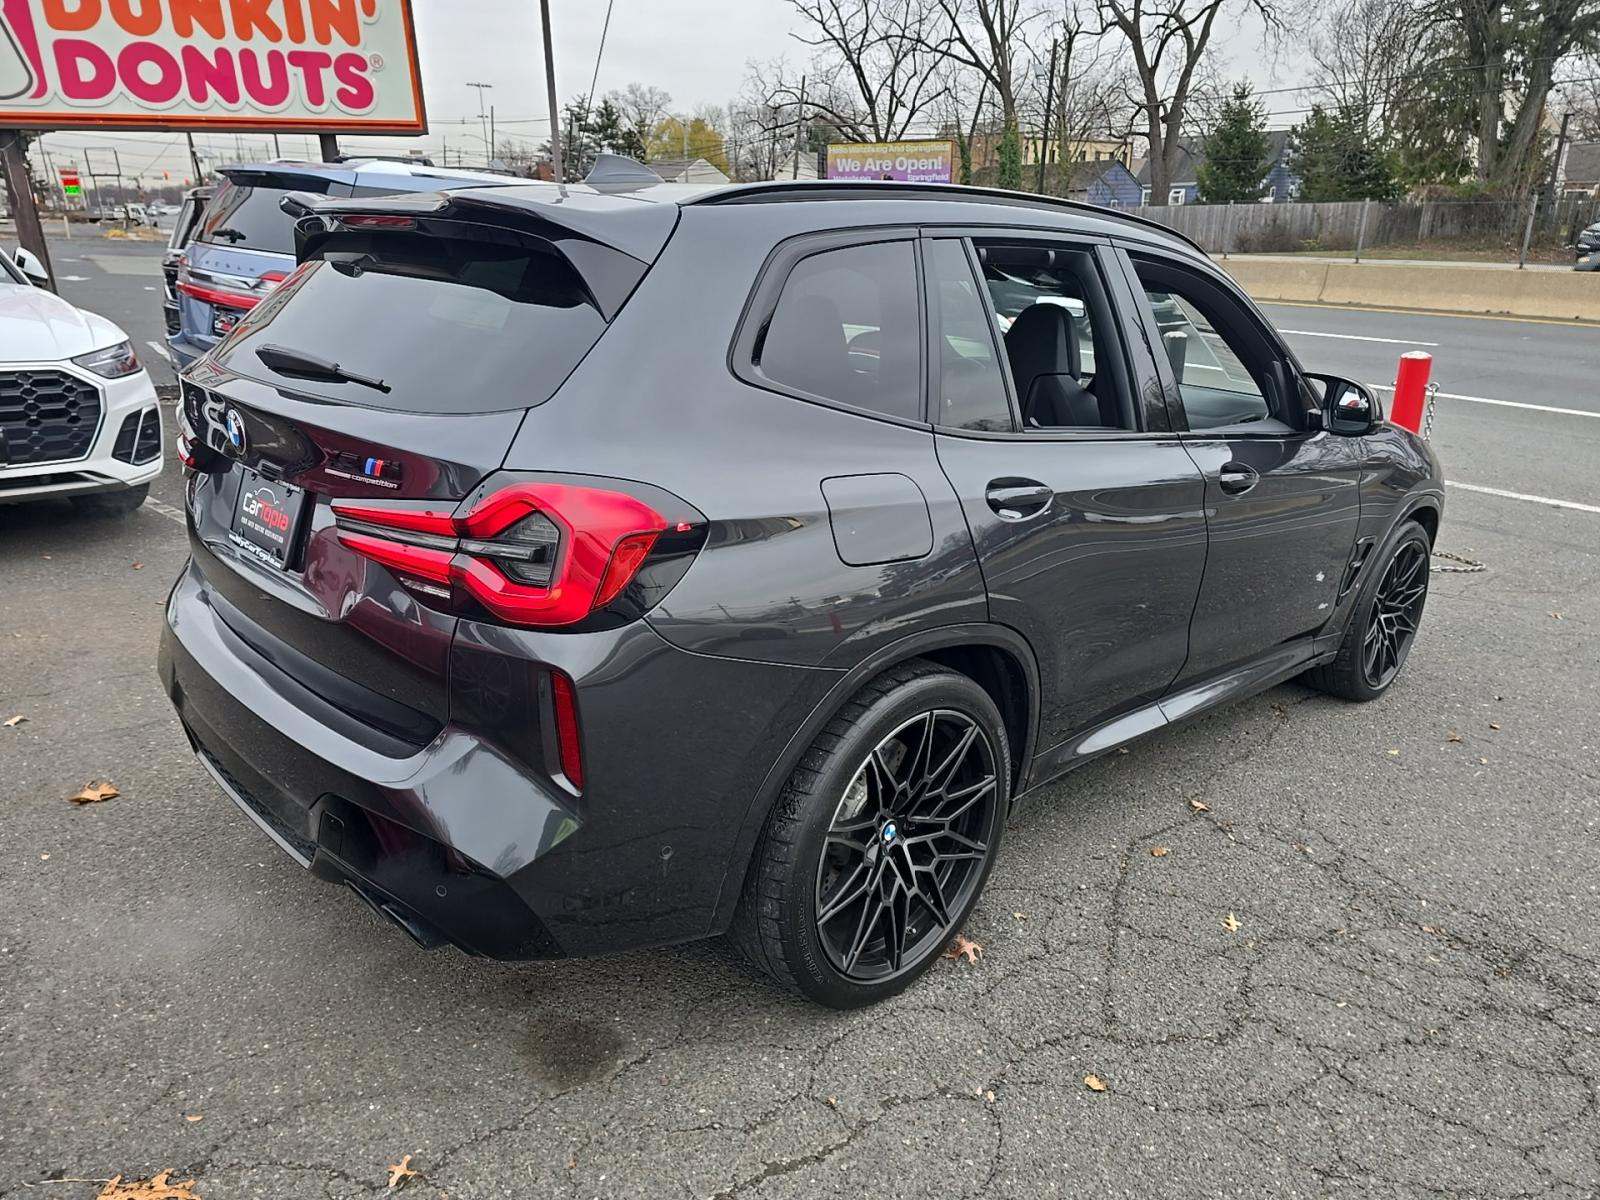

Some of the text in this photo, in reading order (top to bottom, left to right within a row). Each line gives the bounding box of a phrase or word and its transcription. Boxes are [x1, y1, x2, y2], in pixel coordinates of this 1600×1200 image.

[53, 39, 374, 109] DONUTS
[836, 156, 942, 173] We Are Open!
[352, 474, 398, 489] competition
